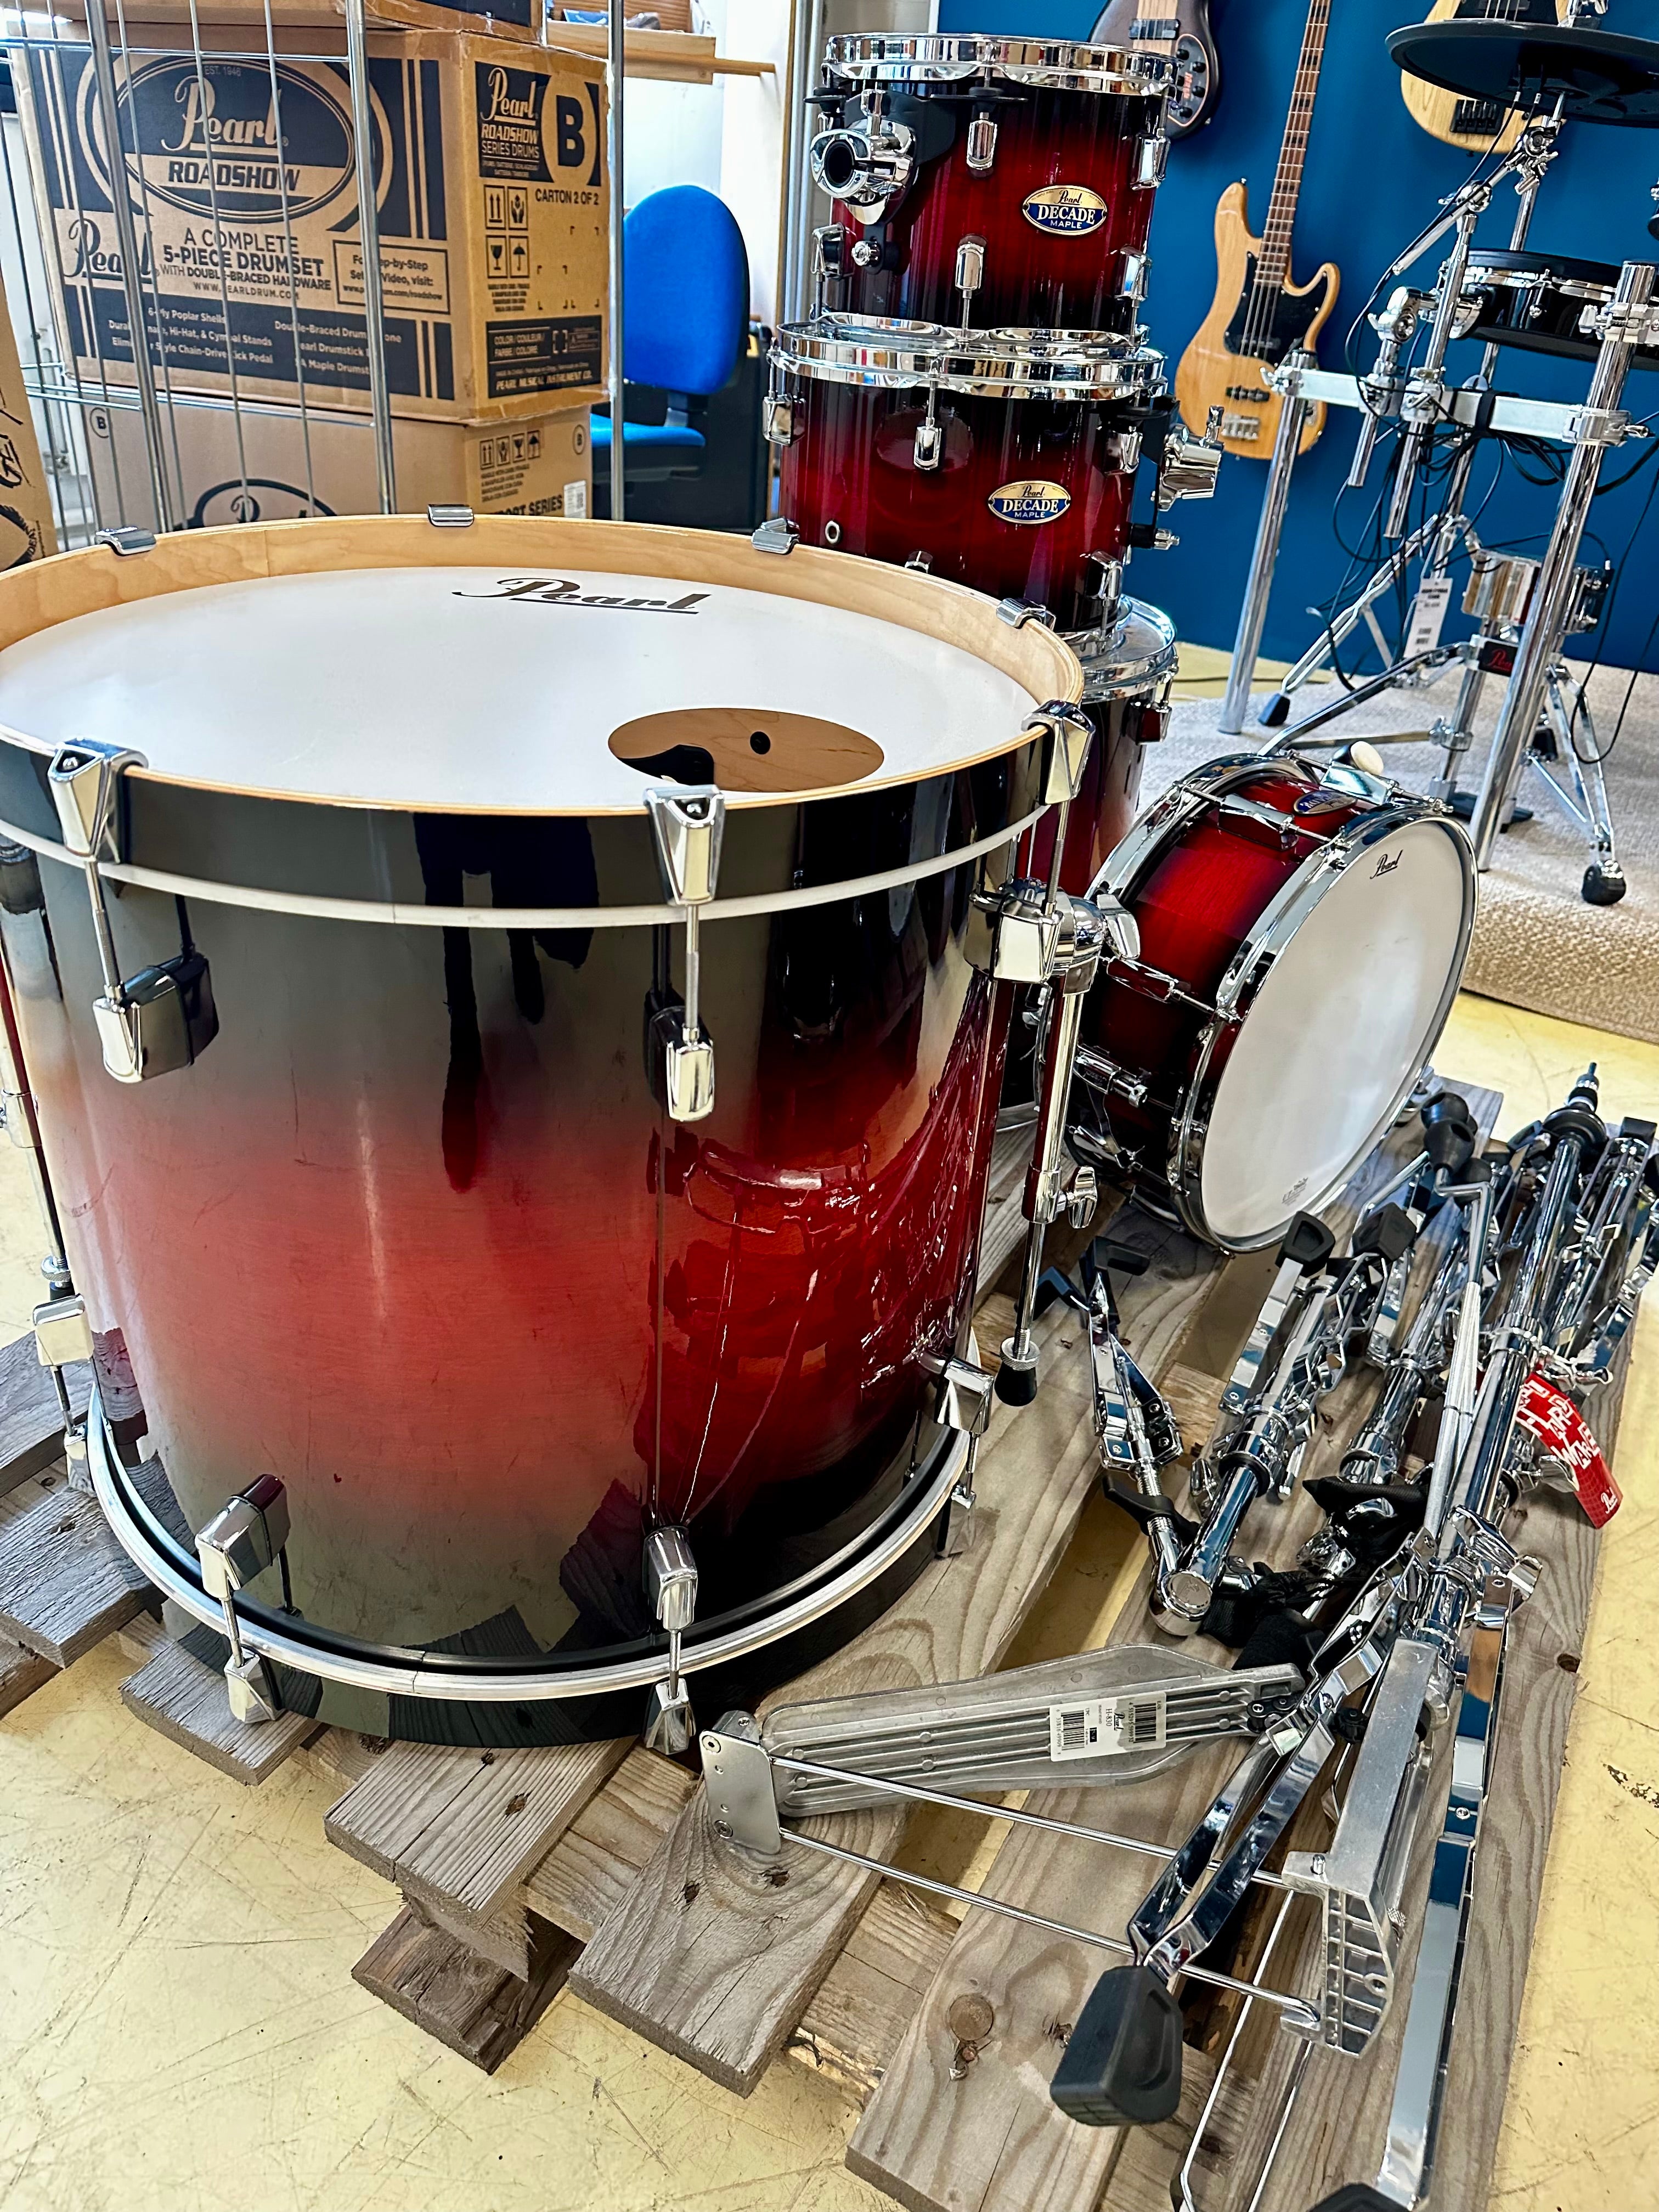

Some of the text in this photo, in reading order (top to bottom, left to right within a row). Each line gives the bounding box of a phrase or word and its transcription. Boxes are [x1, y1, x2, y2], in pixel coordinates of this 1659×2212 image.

[205, 65, 242, 77] EST. 1946
[481, 67, 537, 121] Pearl
[161, 75, 282, 151] Pearl
[481, 123, 539, 145] ROADSHOW
[556, 94, 585, 168] B
[481, 140, 540, 159] SERIES DRUMS
[168, 160, 300, 191] ROADSHOW
[535, 188, 599, 206] CARTON 2 OF 2
[1053, 189, 1082, 204] Pearl
[1036, 205, 1096, 225] DECADE
[1050, 219, 1082, 229] MAPLE
[184, 227, 197, 246] A
[64, 217, 153, 278] Peal
[162, 244, 325, 276] 5-PIECE DRUMSET
[159, 263, 332, 291] WITH DOUBL-BRACED HADWARE
[193, 280, 300, 301] WWW.EARLDRUM.CO
[171, 309, 199, 321] Poplar
[208, 331, 241, 343] Cymal
[242, 333, 273, 347] Stands
[274, 320, 341, 337] Doule-Braced
[341, 327, 367, 339] Drum
[299, 342, 318, 352] earl
[249, 352, 274, 364] Pedal
[308, 359, 335, 372] Maple
[96, 415, 106, 430] B
[1019, 484, 1046, 498] Pearl
[528, 494, 562, 516] SERIES
[1001, 499, 1059, 514] DECADE
[452, 578, 712, 611] Pearl
[1114, 1712, 1125, 1731] Pearl
